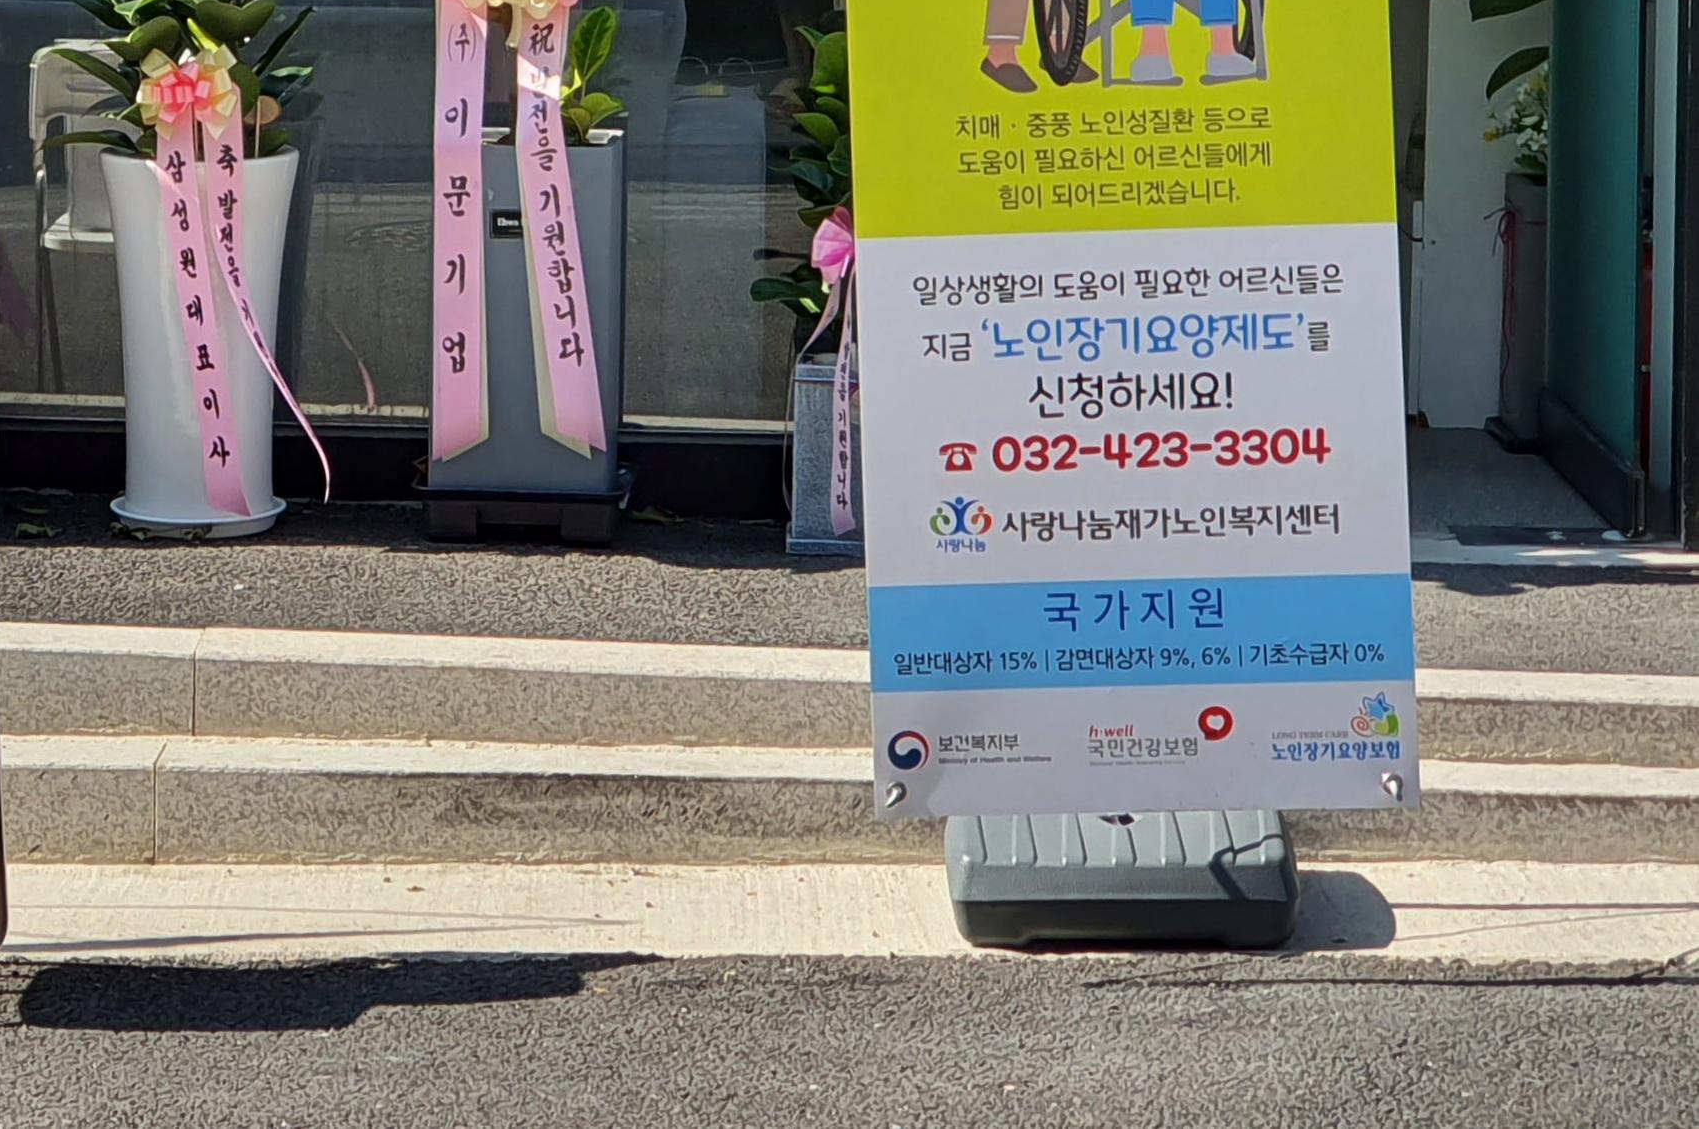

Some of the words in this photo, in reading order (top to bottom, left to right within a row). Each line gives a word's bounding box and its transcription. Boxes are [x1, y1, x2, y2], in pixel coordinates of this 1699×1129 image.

[530, 23, 556, 55] 祝
[956, 114, 1000, 140] 치매
[1026, 112, 1072, 139] 중풍
[1079, 107, 1196, 136] 노인성질환
[1202, 106, 1272, 133] 등으로
[217, 144, 237, 177] 축
[957, 148, 1025, 176] 도움이
[1034, 145, 1125, 174] 필요하신
[1133, 141, 1271, 170] 어르신들에게
[998, 183, 1042, 211] 힘이
[1051, 178, 1241, 209] 되어드리겠습니다.
[218, 190, 240, 287] 발전을
[538, 184, 586, 370] 기원합니다
[912, 272, 1043, 306] 일상생활의
[1054, 270, 1125, 301] 도움이
[1134, 266, 1211, 299] 필요한
[1218, 263, 1344, 295] 어르신들은
[921, 332, 972, 362] 지금
[1029, 371, 1233, 419] 신청하세요!
[992, 427, 1332, 472] 032-423-3304
[1002, 503, 1340, 542] 사랑나눔재가노인복지센터
[936, 538, 986, 553] 사랑나눔
[893, 650, 993, 676] 일반대상자
[999, 651, 1038, 671] 15%
[1055, 646, 1155, 672] 감면대상자
[1159, 647, 1196, 669] 9%,
[1201, 646, 1231, 666] 6%
[1250, 642, 1349, 667] 기초수급자
[1354, 643, 1385, 663] 0%
[939, 734, 1019, 752] 보건복지부
[1087, 737, 1199, 759] 국민건강보험
[1271, 741, 1400, 760] 노인장기요양보험
